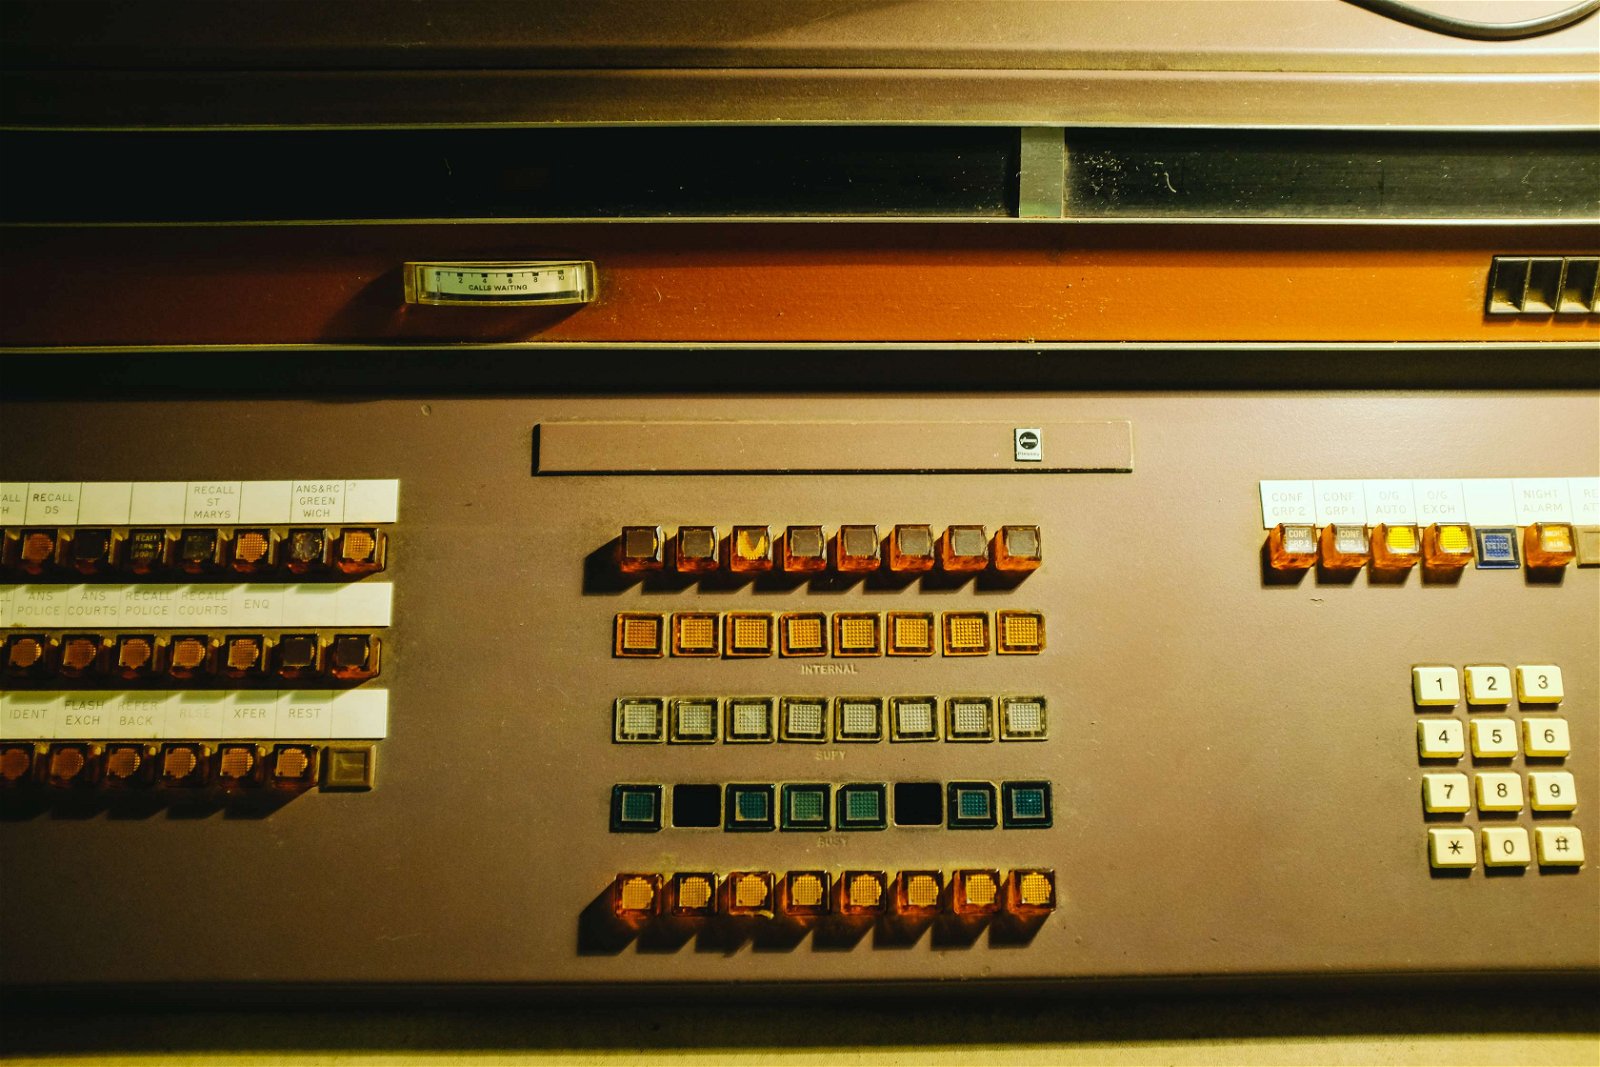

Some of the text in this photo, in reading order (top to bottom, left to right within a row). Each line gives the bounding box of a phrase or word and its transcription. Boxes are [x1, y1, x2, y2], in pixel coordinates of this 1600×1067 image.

[194, 486, 235, 495] RECALL
[296, 484, 340, 493] ANS&RC
[0, 494, 20, 502] ALL
[33, 493, 73, 502] RECALL
[1271, 492, 1303, 502] CONF
[1323, 492, 1354, 502] CONF
[1523, 489, 1558, 499] NIGHT
[206, 498, 221, 506] ST
[299, 496, 336, 505] GREEN
[45, 505, 59, 514] DS
[1272, 506, 1306, 516] GRP 2
[1325, 506, 1347, 516] GRP
[1375, 504, 1407, 514] AUTO
[1423, 504, 1456, 514] EXCH
[1523, 503, 1563, 512] ALARM
[193, 510, 231, 519] MARYS
[303, 509, 330, 518] WICH
[1288, 530, 1308, 538] CONF
[1340, 530, 1360, 538] CONF
[28, 592, 54, 601] ANS
[81, 592, 106, 601] ANS
[125, 591, 173, 601] RECALL
[181, 591, 228, 601] RECALL
[244, 599, 270, 609] ENQ
[17, 606, 60, 615] POLICE
[68, 606, 117, 615] COURTS
[125, 606, 169, 615] POLICE
[178, 605, 229, 615] COURTS
[801, 664, 858, 675] INTERNAL
[1435, 677, 1443, 691] 1
[1486, 676, 1498, 691] 2
[1537, 674, 1548, 689] 3
[64, 700, 104, 710] FLASH
[118, 700, 158, 711] REFER
[9, 709, 48, 719] IDENT
[233, 708, 267, 719] XFER
[288, 708, 321, 719] REST
[65, 715, 100, 725] EXCH
[119, 715, 153, 726] BACK
[1438, 730, 1450, 743] 4
[1492, 729, 1502, 744] 5
[1544, 729, 1555, 743] 6
[1443, 784, 1454, 799] 7
[1497, 783, 1508, 798] 8
[1549, 783, 1561, 798] 9
[816, 836, 848, 848] BUSY
[1503, 839, 1514, 854] 0
